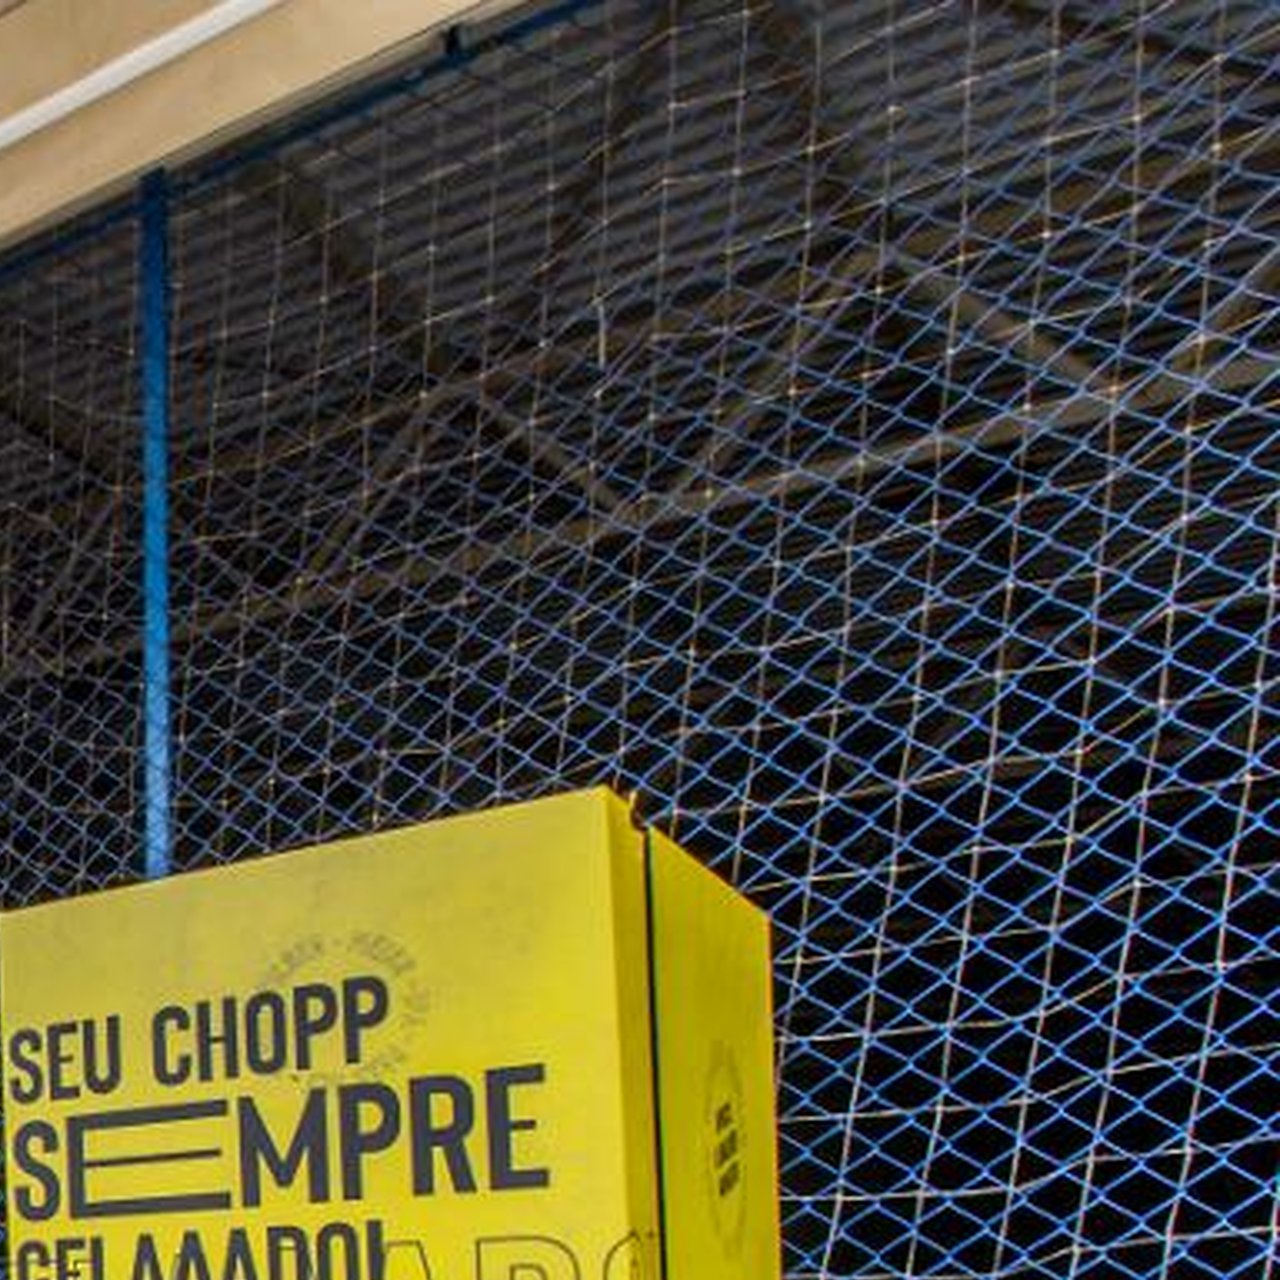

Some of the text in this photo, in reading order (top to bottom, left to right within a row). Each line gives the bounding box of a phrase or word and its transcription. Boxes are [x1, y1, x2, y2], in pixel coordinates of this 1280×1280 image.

[7, 1014, 122, 1103] SEU
[152, 975, 389, 1087] CHOPP
[12, 1063, 550, 1221] SEMPRE
